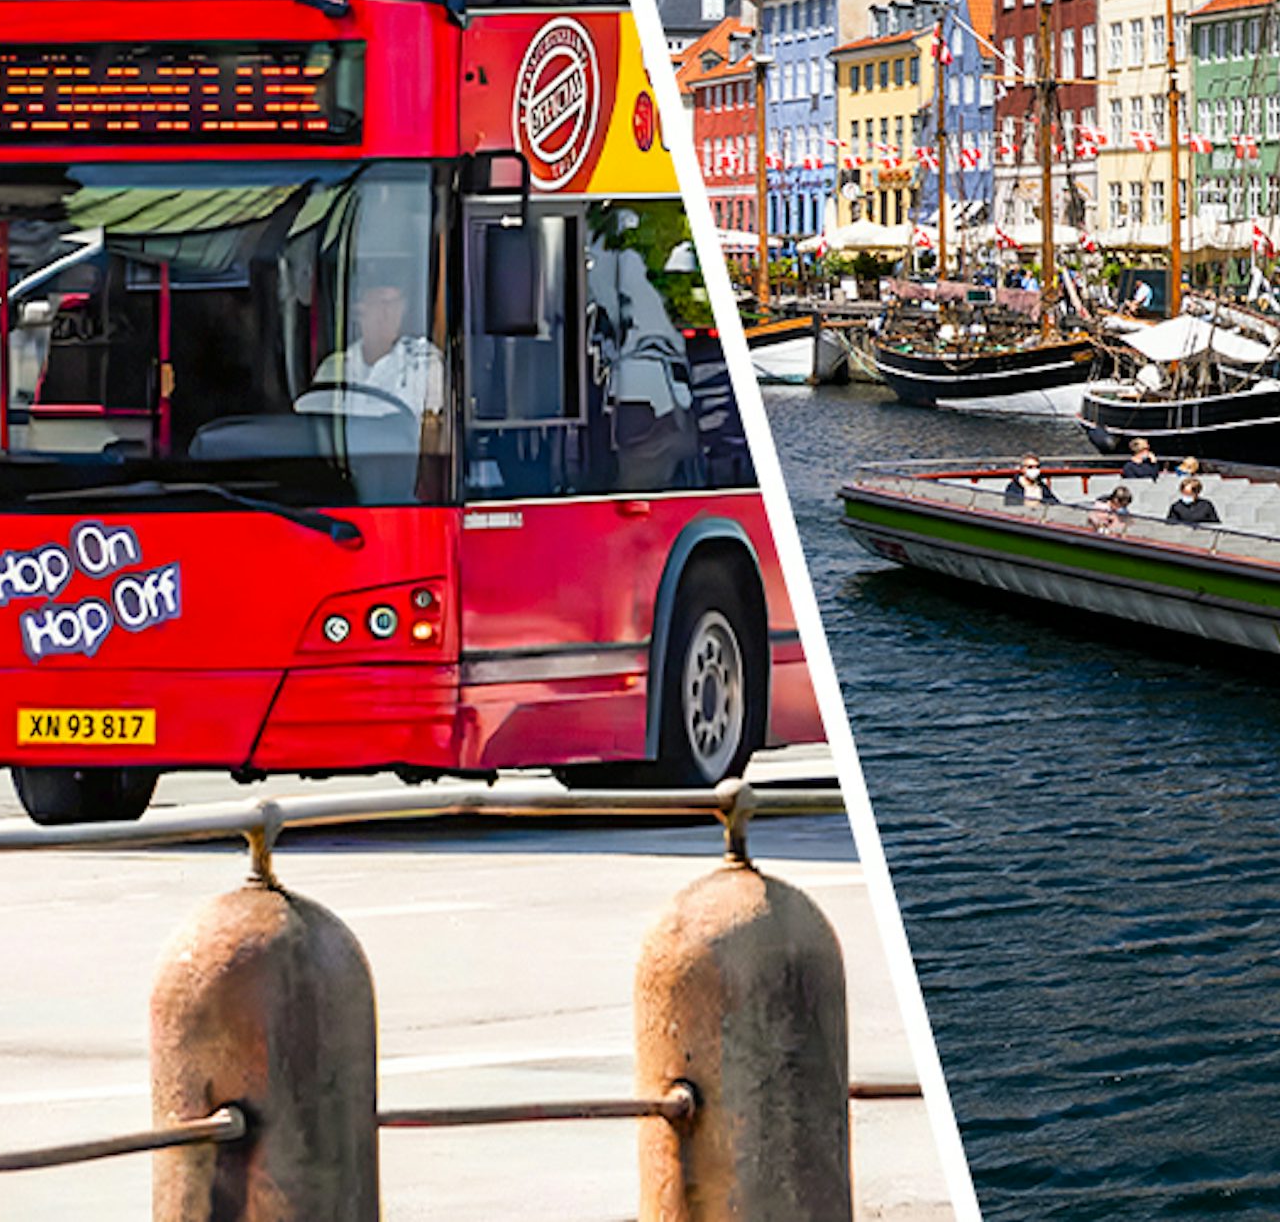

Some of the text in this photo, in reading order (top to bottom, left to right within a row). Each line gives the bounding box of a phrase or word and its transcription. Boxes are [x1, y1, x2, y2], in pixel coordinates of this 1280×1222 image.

[30, 714, 145, 738] XN 93 817
